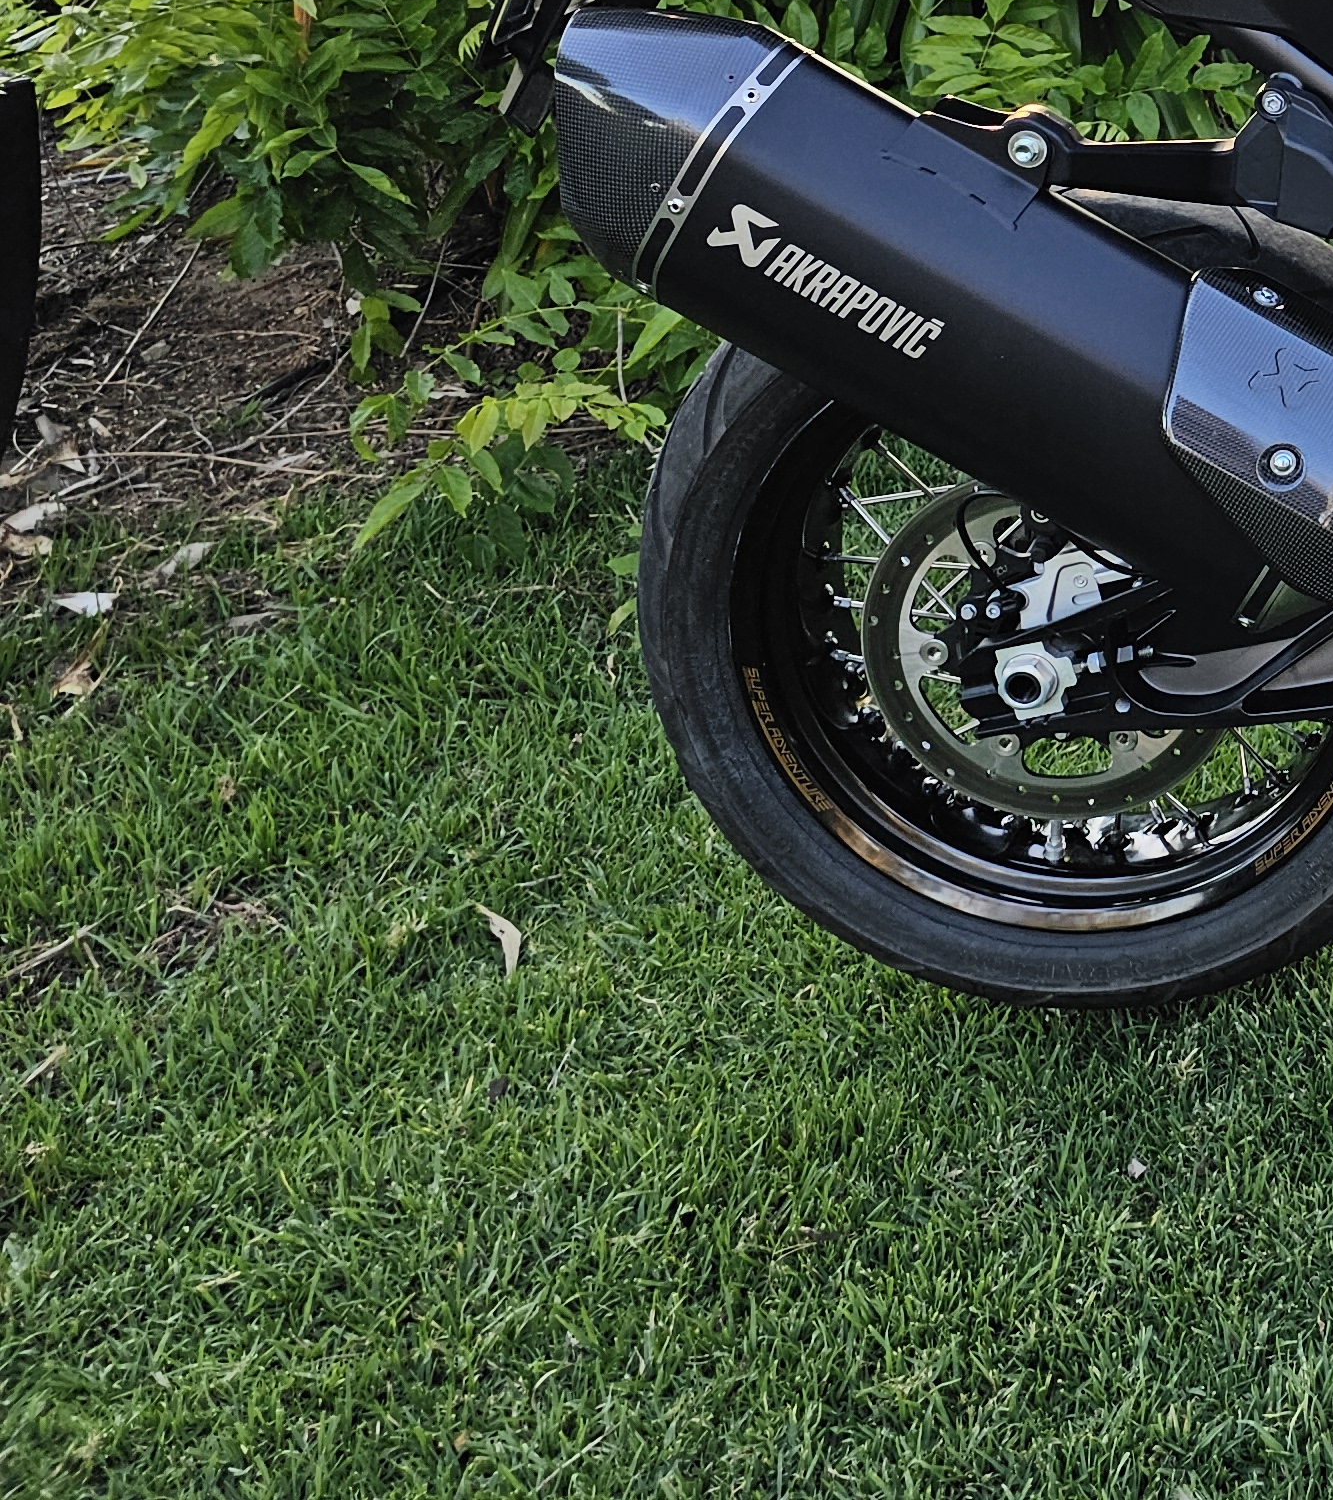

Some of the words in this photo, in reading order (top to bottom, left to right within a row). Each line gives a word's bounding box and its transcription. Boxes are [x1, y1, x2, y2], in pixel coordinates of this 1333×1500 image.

[747, 666, 775, 725] SUPER
[768, 727, 834, 813] ADVENTURE
[1254, 826, 1302, 871] SUPER
